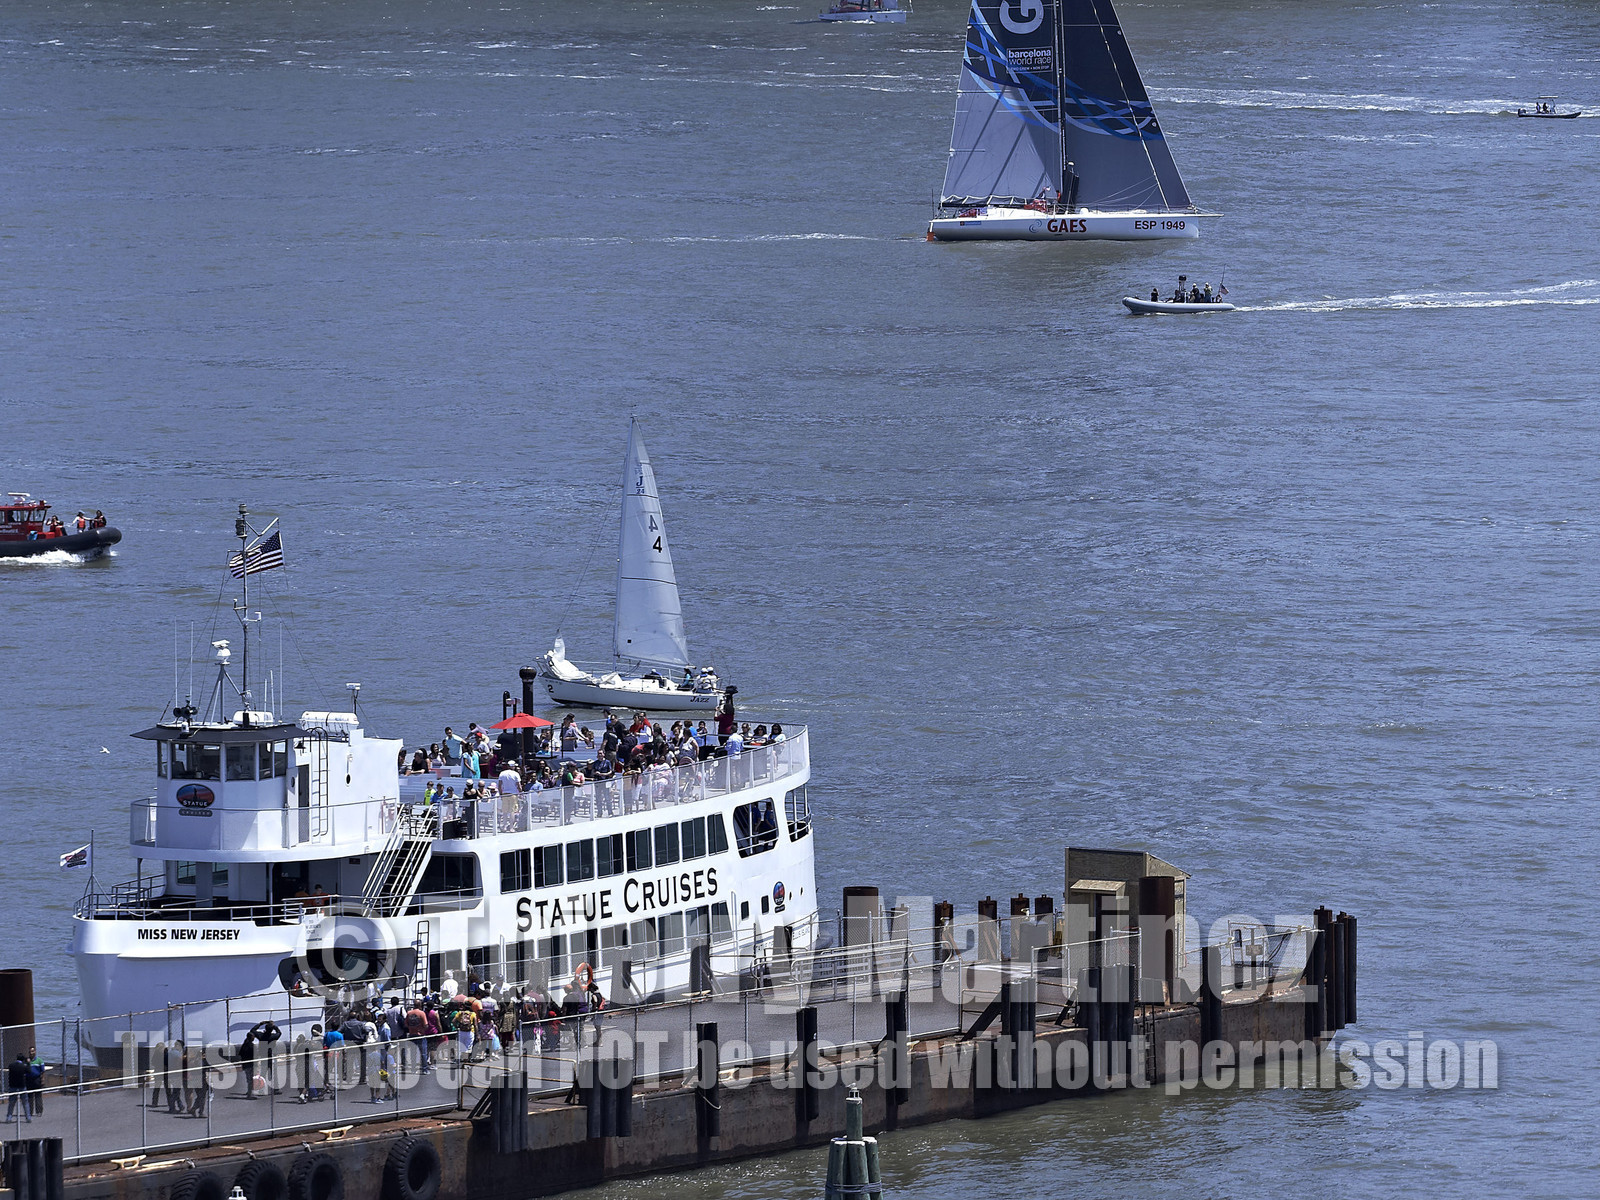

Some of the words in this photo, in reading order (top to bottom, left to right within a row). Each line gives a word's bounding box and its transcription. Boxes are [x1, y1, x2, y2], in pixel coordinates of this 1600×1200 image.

[1008, 49, 1051, 58] barcelona
[1009, 57, 1032, 65] world
[1047, 218, 1087, 233] GAES
[1134, 220, 1157, 230] ESP
[1160, 220, 1186, 230] 1949
[636, 475, 643, 486] J
[653, 536, 662, 553] 4
[547, 684, 555, 694] 2
[516, 889, 613, 932] STATUE
[623, 867, 718, 913] CRUISES
[138, 928, 167, 940] MISS
[171, 928, 198, 940] NEW
[201, 928, 240, 941] JERSEY
